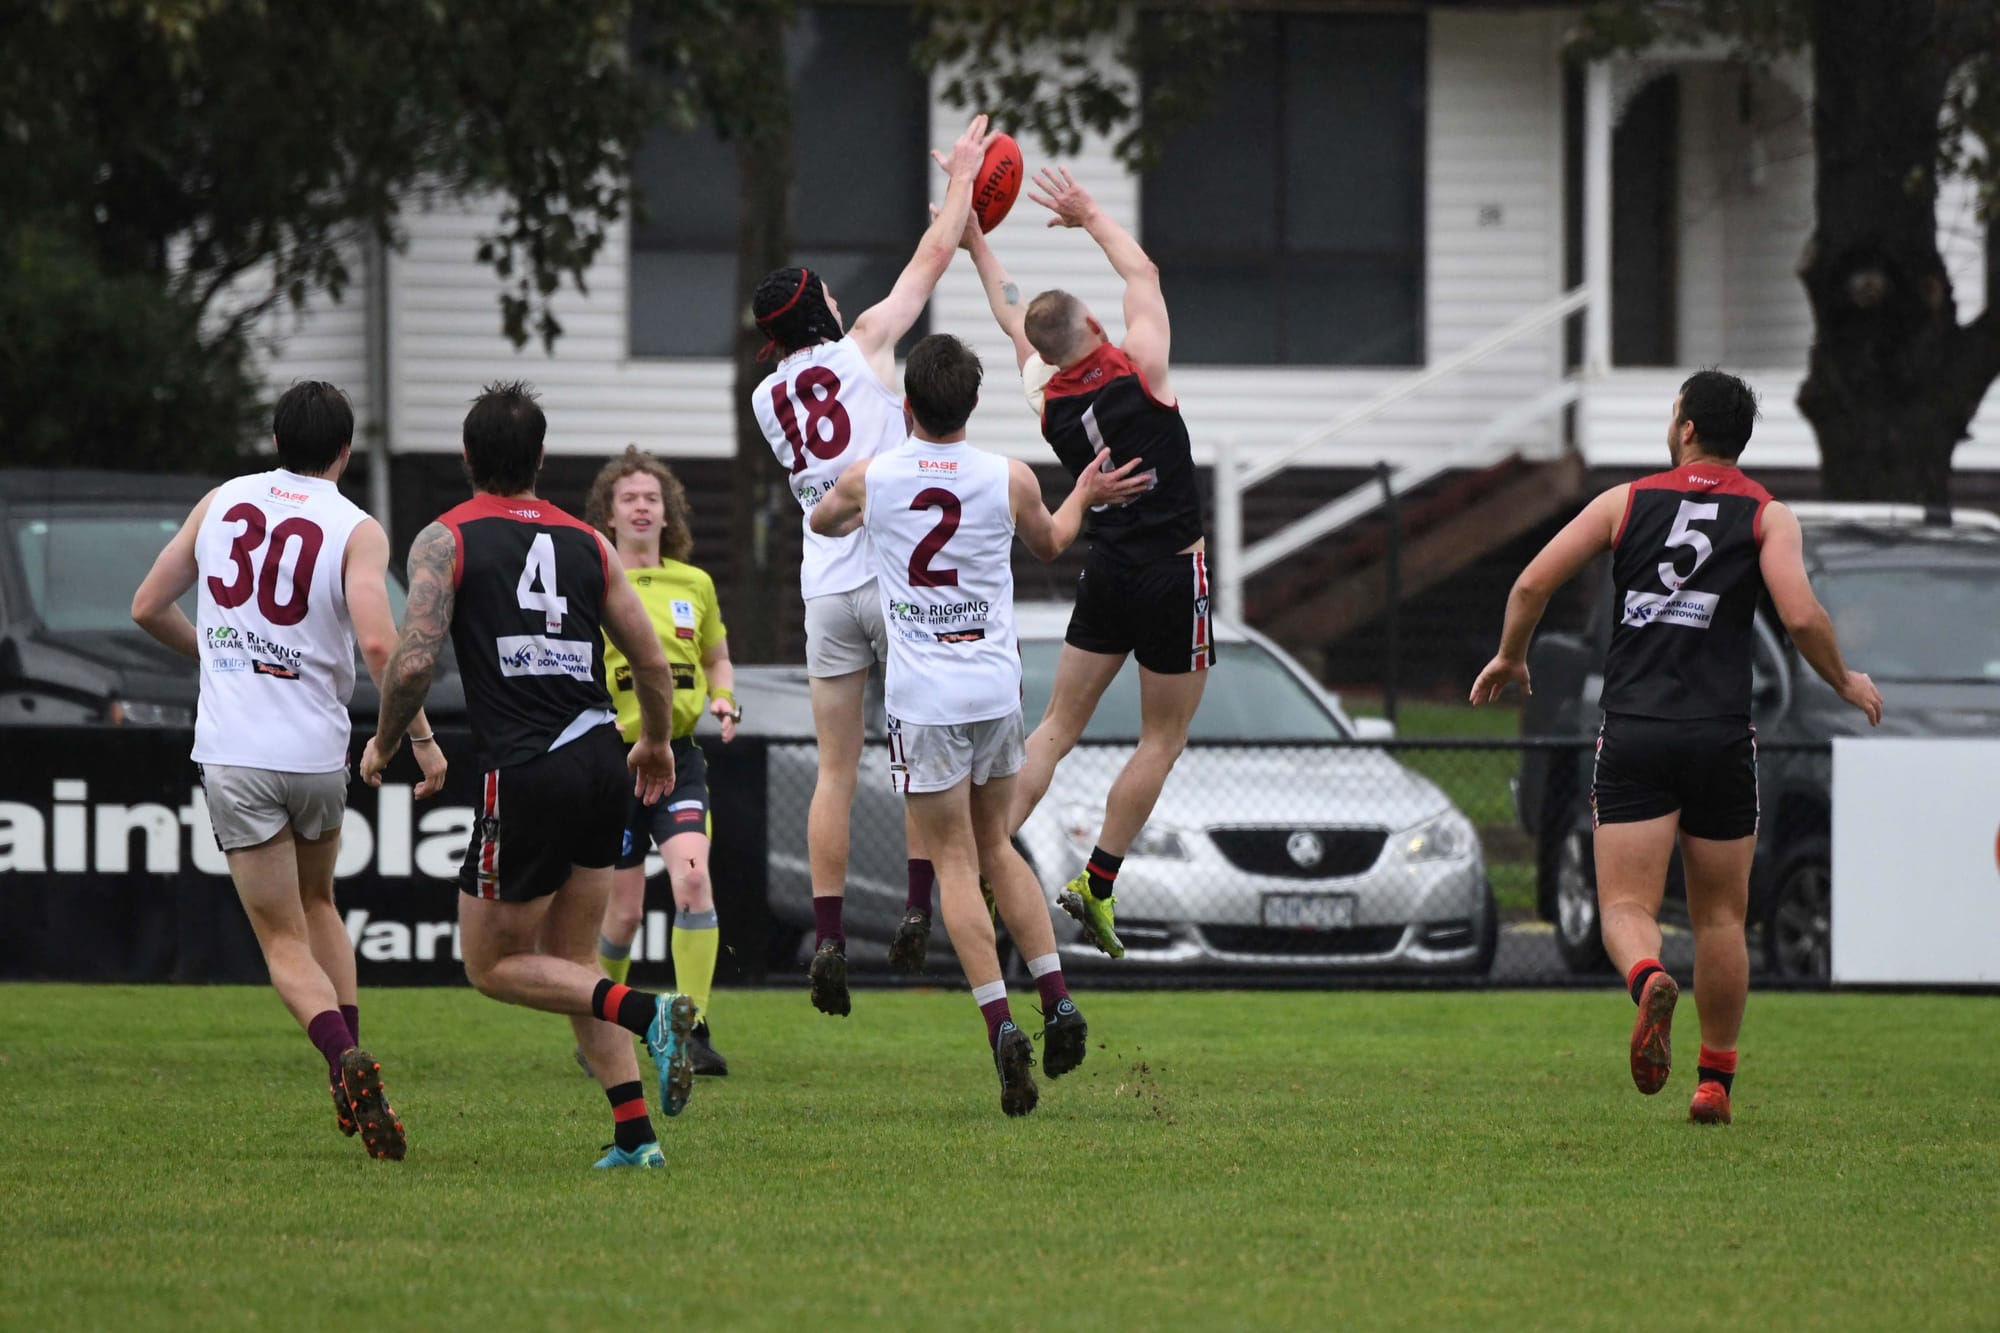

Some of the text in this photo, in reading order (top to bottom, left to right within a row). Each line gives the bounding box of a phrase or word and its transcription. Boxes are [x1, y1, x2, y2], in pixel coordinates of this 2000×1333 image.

[772, 366, 851, 474] 18
[918, 460, 957, 471] BASE
[270, 486, 309, 503] BASE
[909, 488, 961, 588] 2
[208, 503, 324, 626] 30
[517, 533, 568, 634] 4
[1658, 500, 1719, 591] 5
[930, 601, 989, 617] RIGGING
[1664, 600, 1705, 612] ARRAGUL
